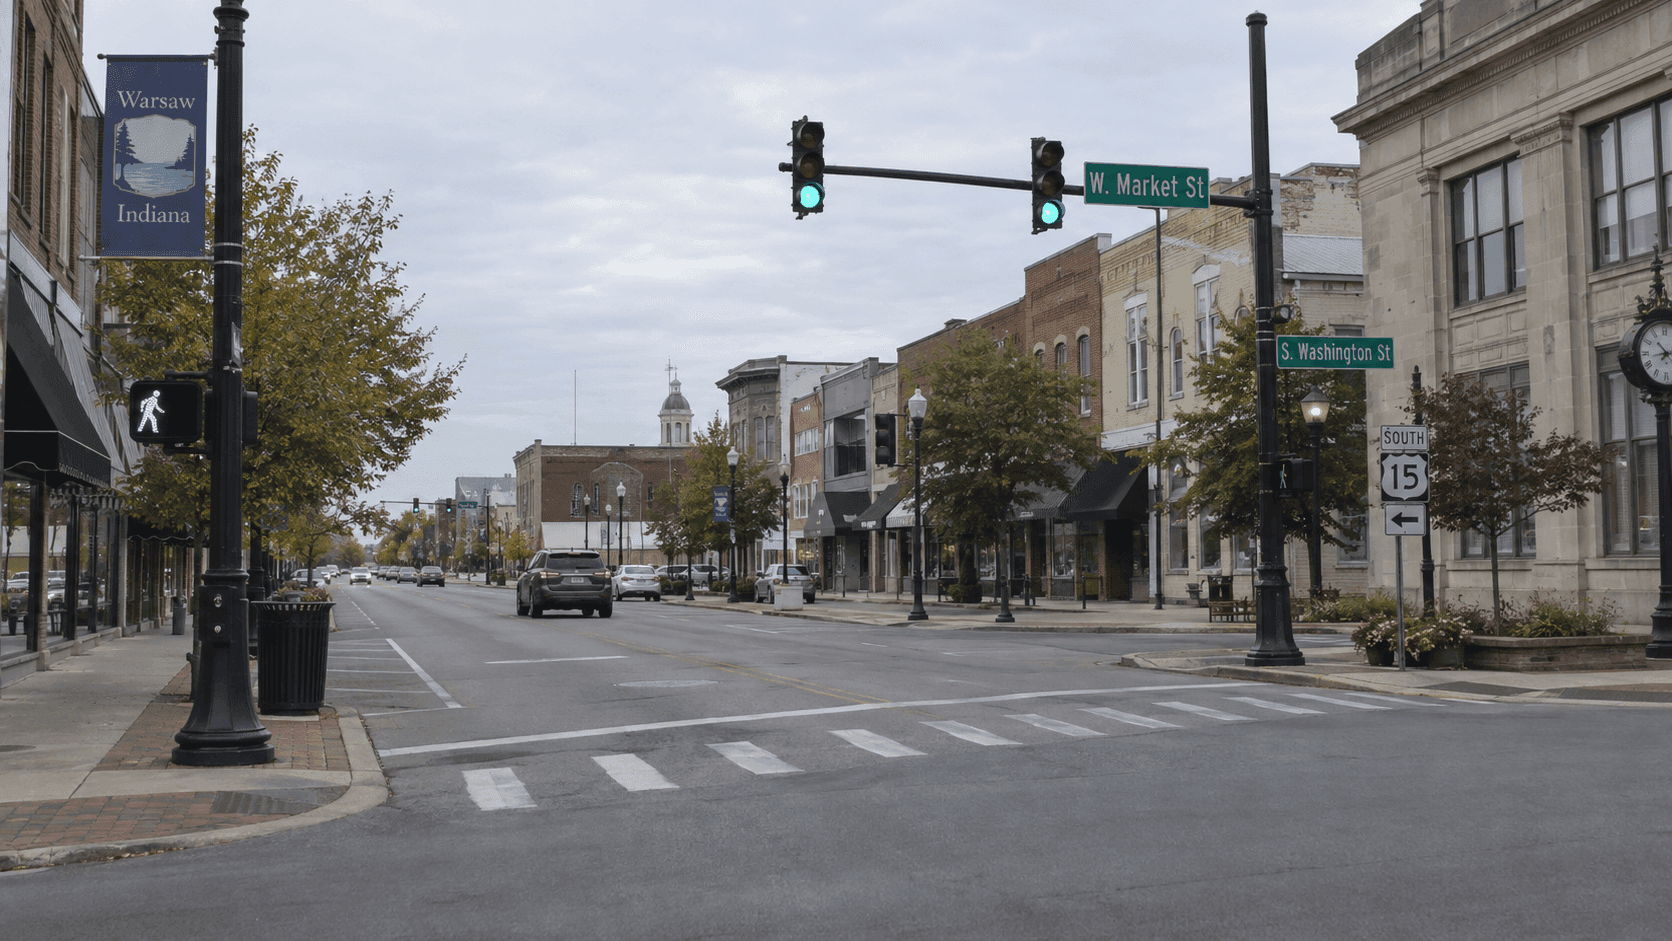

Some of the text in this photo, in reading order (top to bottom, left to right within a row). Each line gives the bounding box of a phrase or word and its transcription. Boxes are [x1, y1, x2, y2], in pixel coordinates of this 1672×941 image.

[117, 90, 196, 109] Warsaw
[1089, 171, 1205, 199] W. Market St
[117, 202, 191, 223] Indiana
[1281, 341, 1391, 366] S. Washington St
[1383, 430, 1425, 445] SOUTH
[1390, 463, 1419, 490] 15
